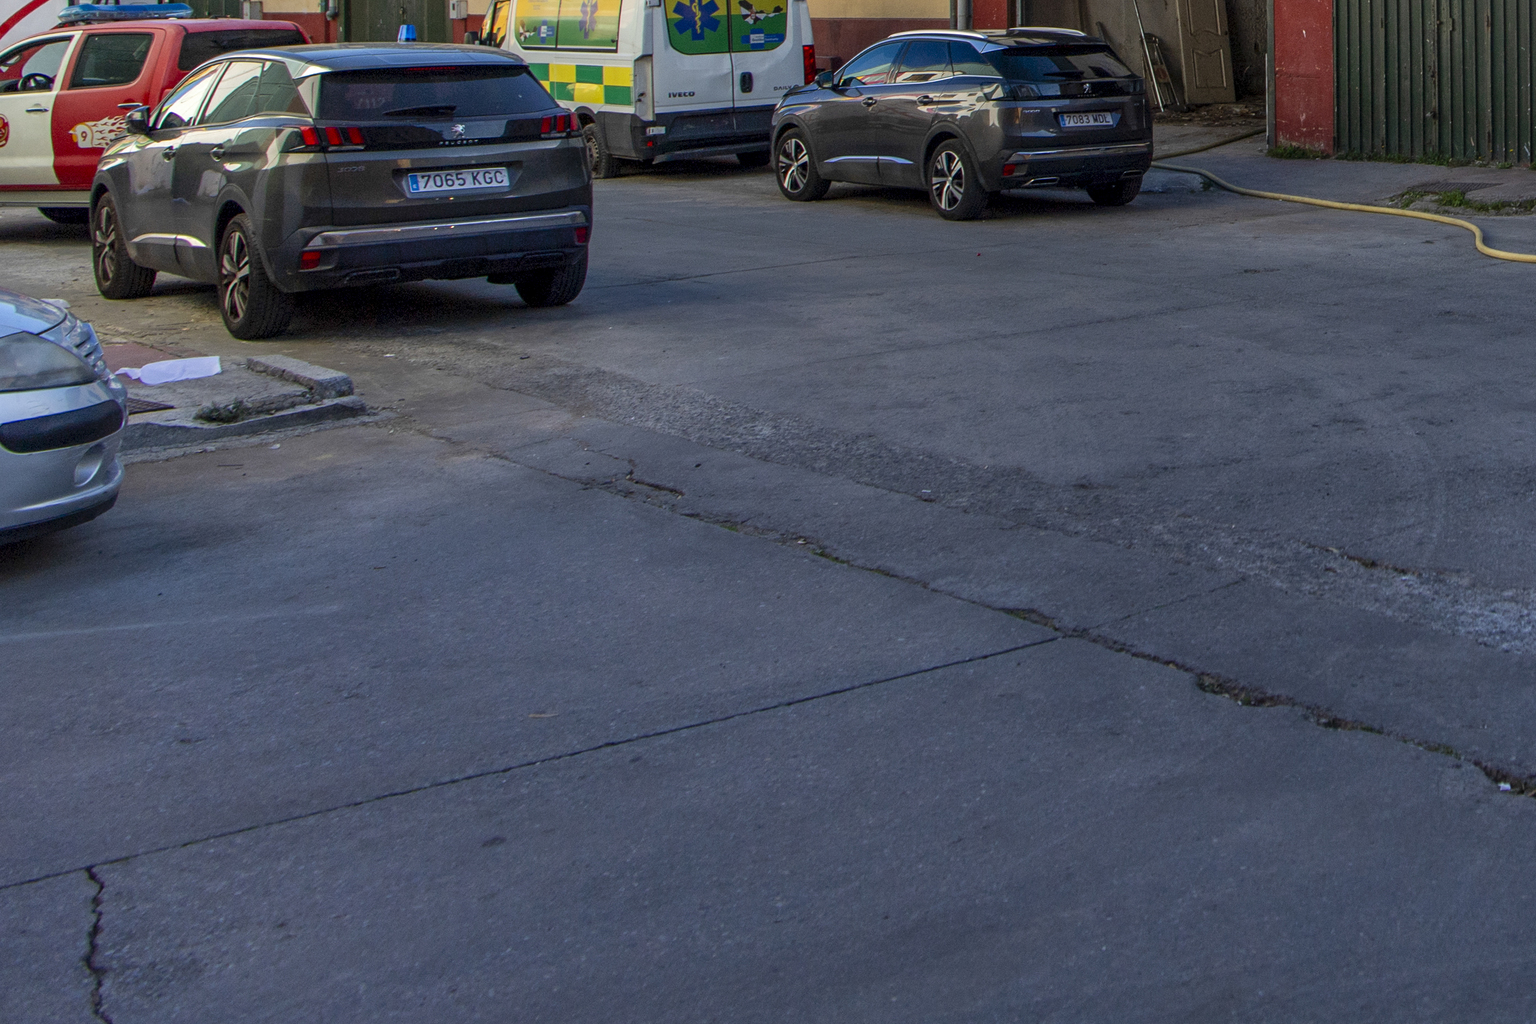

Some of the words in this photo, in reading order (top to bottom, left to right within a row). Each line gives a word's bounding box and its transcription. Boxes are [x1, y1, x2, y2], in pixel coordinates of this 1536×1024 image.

[1065, 114, 1090, 125] 7083
[80, 130, 88, 142] 9
[421, 174, 467, 190] 7065
[471, 170, 504, 186] KGC
